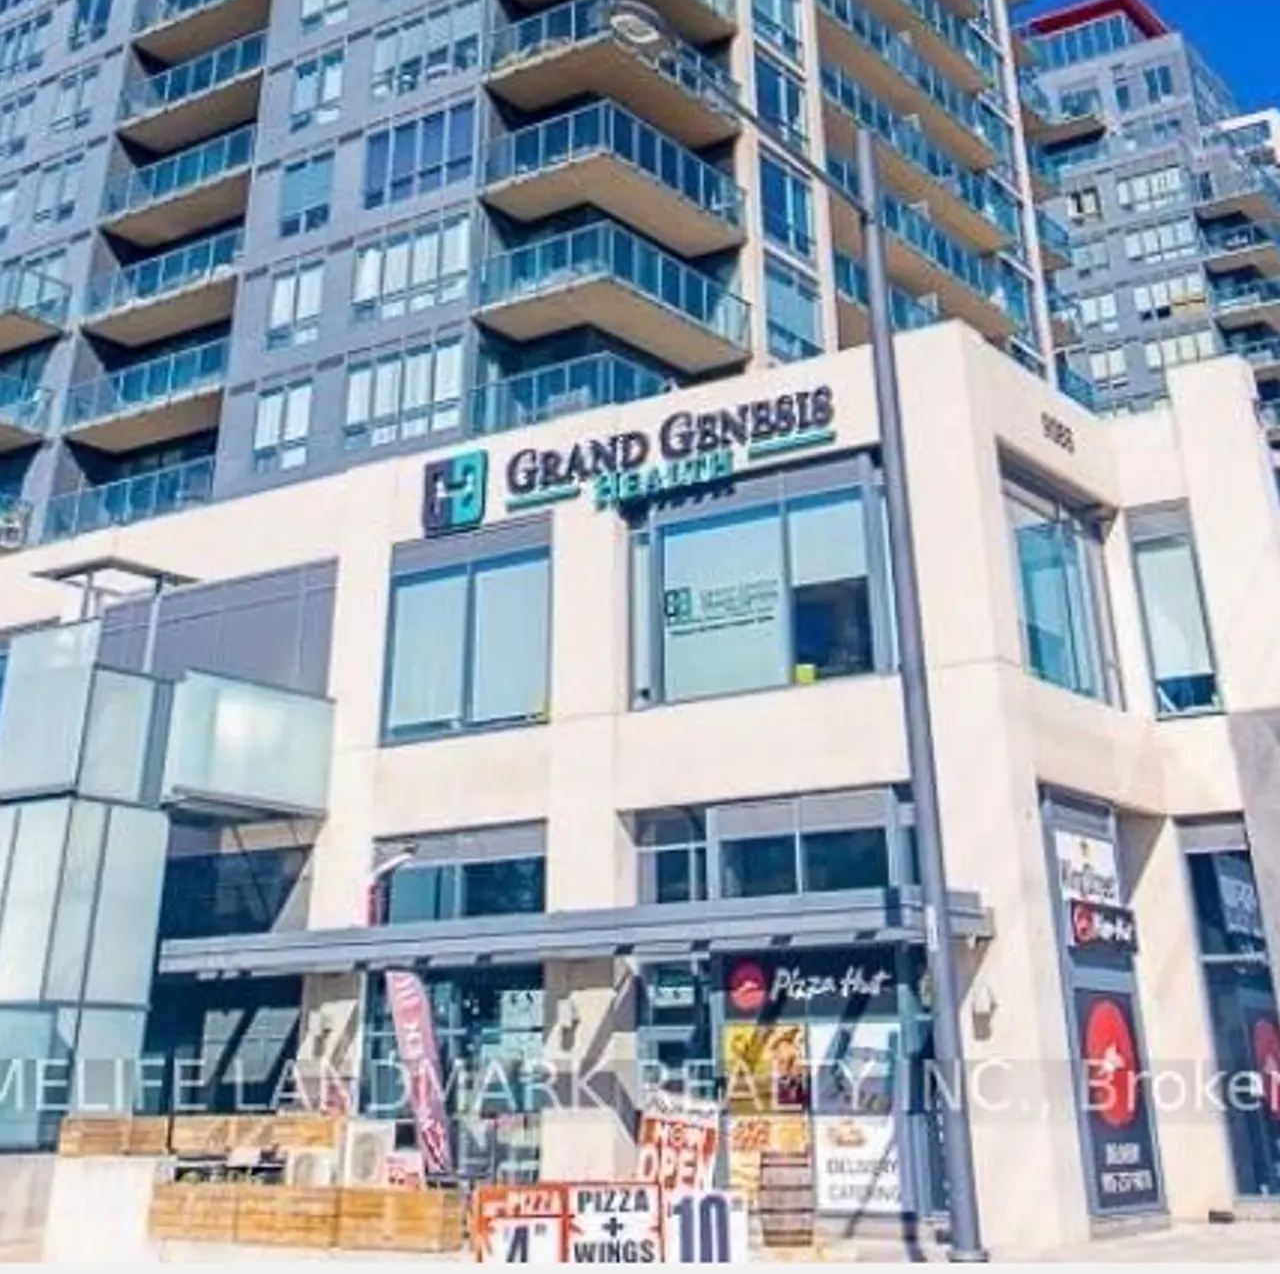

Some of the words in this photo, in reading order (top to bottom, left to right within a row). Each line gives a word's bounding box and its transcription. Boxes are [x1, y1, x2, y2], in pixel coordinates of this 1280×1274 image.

[506, 431, 650, 495] GRAND
[660, 386, 835, 456] GENESIS
[593, 448, 733, 509] HEALTH
[770, 965, 837, 1001] Pizza
[840, 965, 892, 998] Hut
[577, 1189, 650, 1213] PIZZA
[573, 1239, 655, 1263] WINGS
